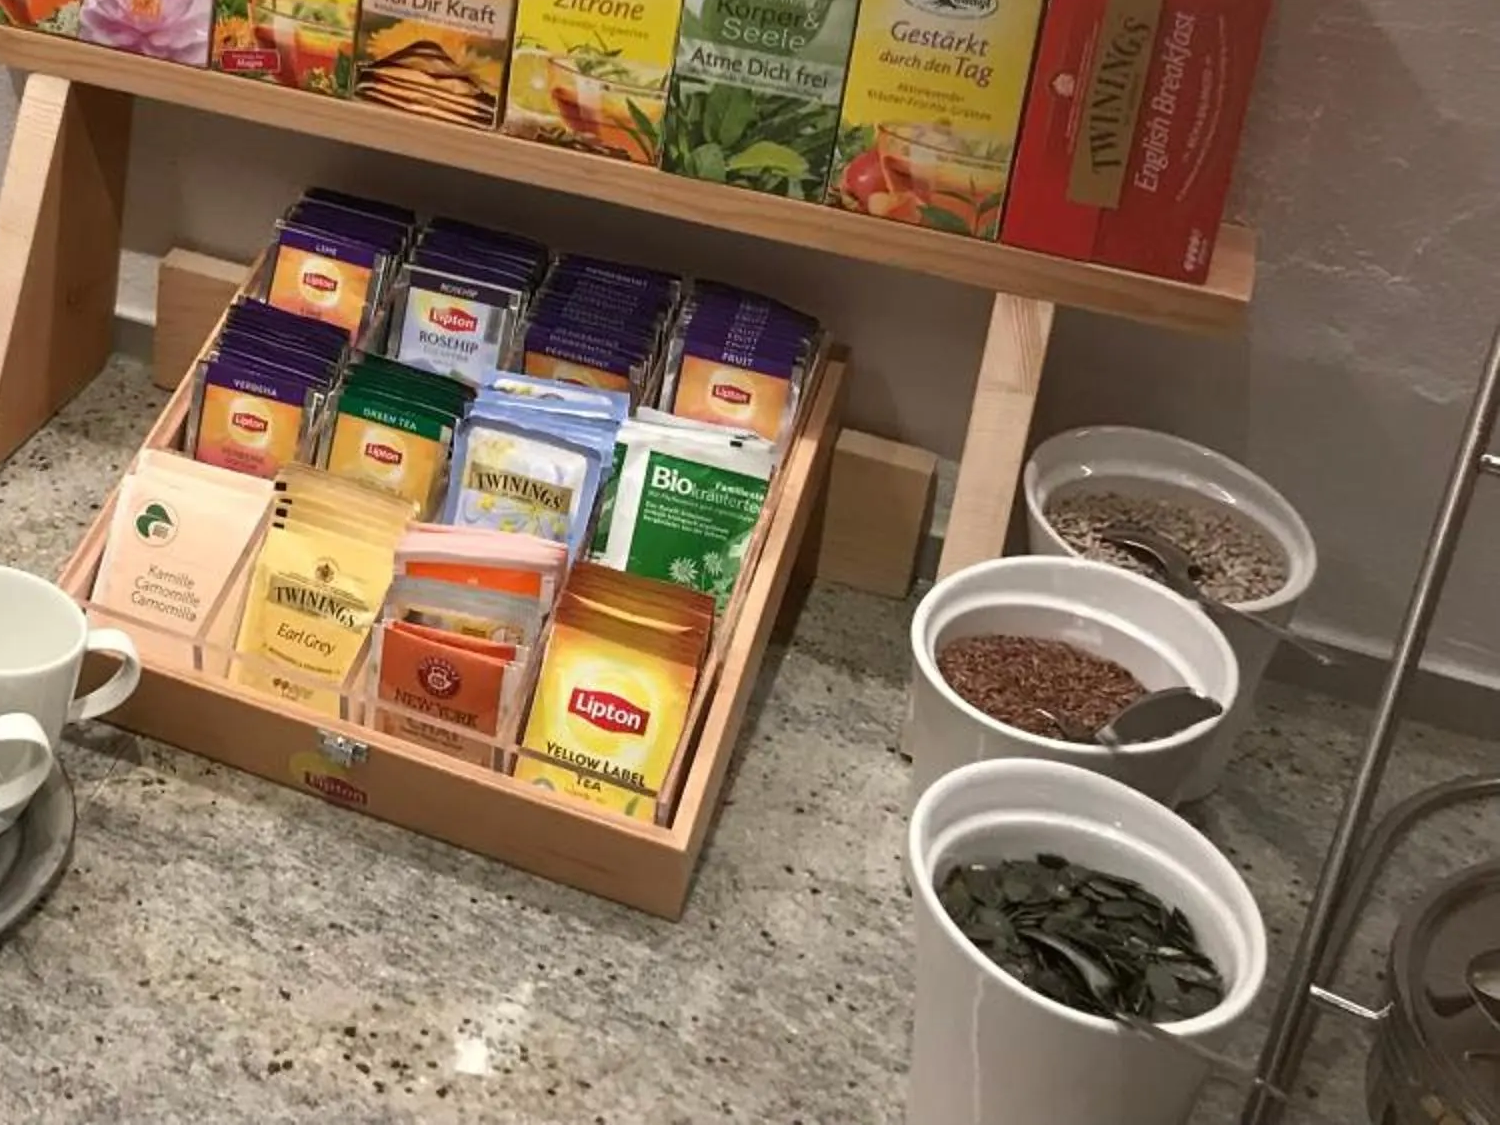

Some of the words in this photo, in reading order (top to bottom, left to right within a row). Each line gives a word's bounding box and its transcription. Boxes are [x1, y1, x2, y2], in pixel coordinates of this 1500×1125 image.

[722, 16, 806, 53] Seele
[689, 47, 743, 74] Atme
[747, 57, 792, 83] Dich
[796, 68, 829, 90] frei
[878, 49, 921, 70] durch
[923, 57, 952, 75] den
[954, 55, 994, 88] Tag
[1151, 11, 1197, 114] Breakfast
[1089, 16, 1151, 175] TWININGS
[1134, 116, 1172, 193] English
[433, 309, 475, 329] Lipton
[419, 330, 479, 356] ROSEHIP
[722, 352, 754, 367] FRUIT
[399, 417, 418, 433] TEA
[474, 472, 561, 510] TWININGS
[147, 563, 196, 590] Kamille
[273, 585, 355, 628] TWININGS
[276, 621, 305, 644] Earl
[304, 633, 337, 657] Grey
[575, 692, 642, 731] Lipton
[546, 740, 602, 771] YELLOW
